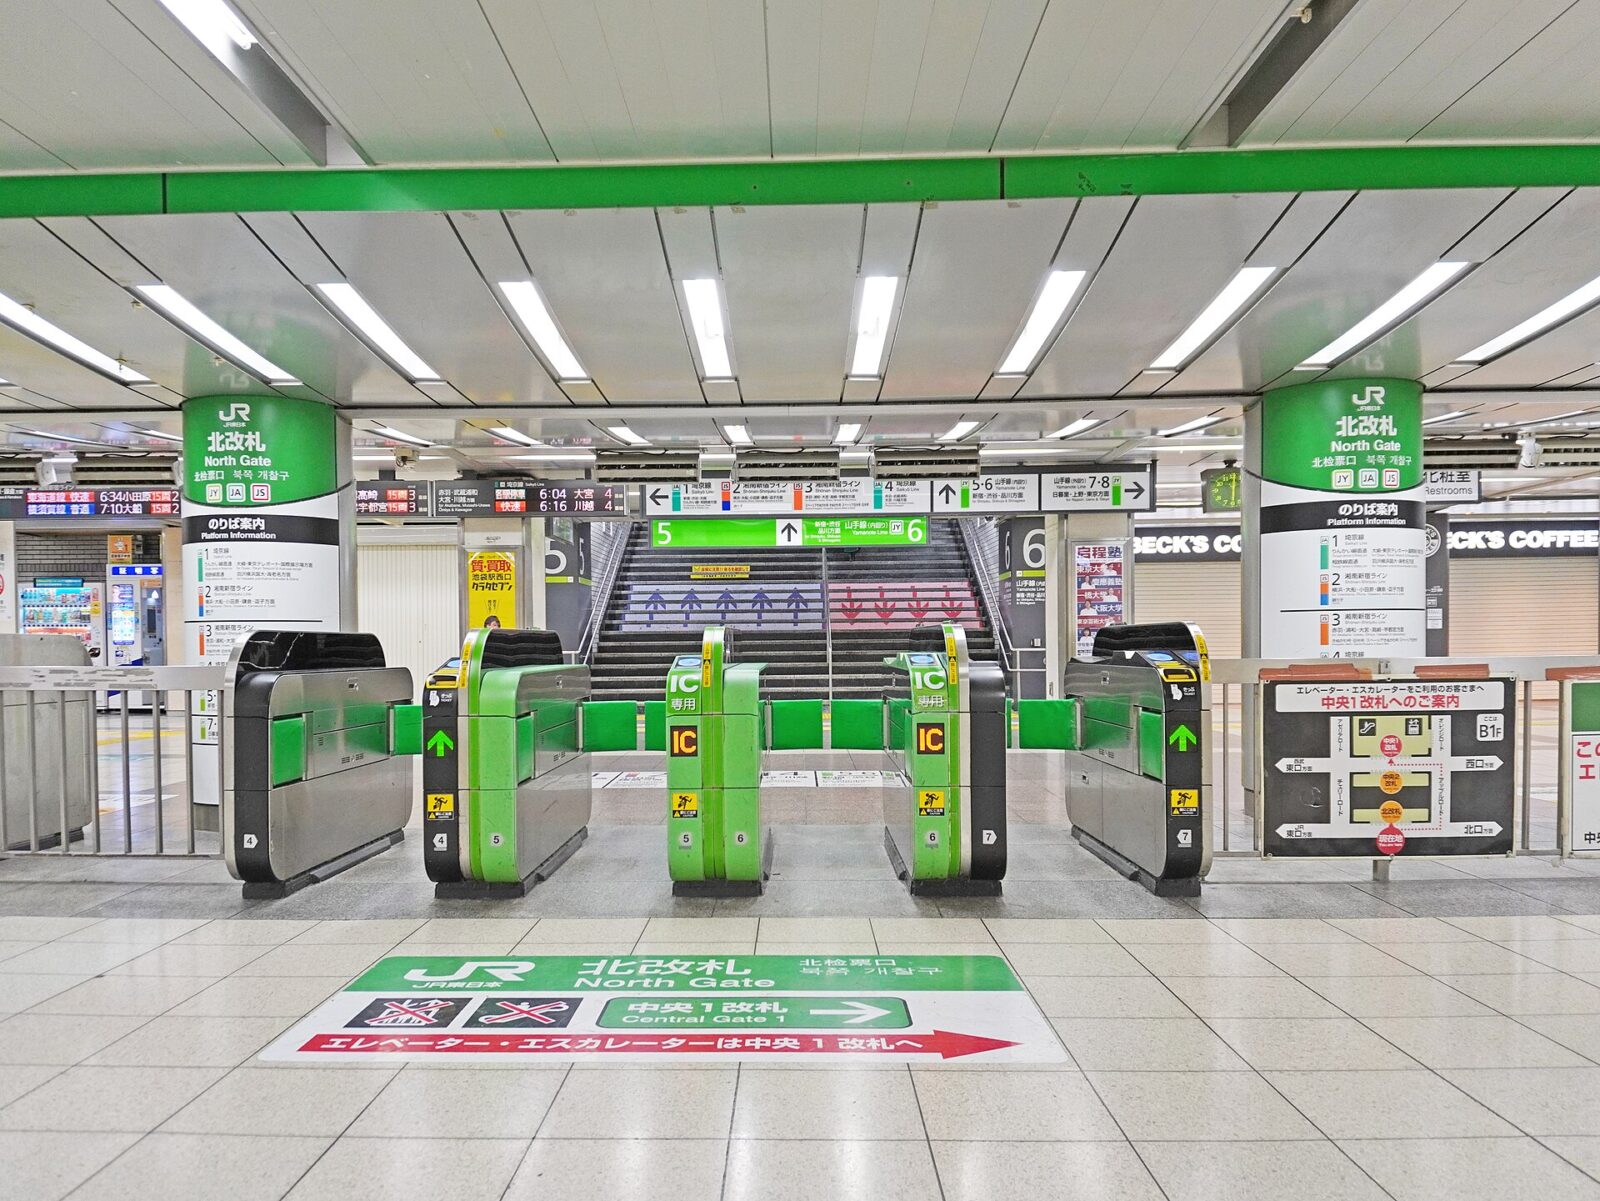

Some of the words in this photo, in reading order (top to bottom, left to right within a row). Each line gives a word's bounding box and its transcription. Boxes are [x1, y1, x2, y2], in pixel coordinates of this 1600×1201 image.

[1352, 386, 1386, 404] JR
[218, 403, 250, 420] JR
[1336, 415, 1397, 436] 北改札
[208, 432, 266, 452] 北改札
[1331, 440, 1370, 452] North
[1374, 440, 1400, 451] Gate
[204, 456, 236, 466] North
[240, 455, 272, 466] Gate
[1366, 456, 1386, 464] 북쪽
[232, 470, 252, 480] 북쪽
[258, 470, 289, 480] 개찰구
[806, 483, 812, 492] 3
[885, 481, 893, 491] 4
[70, 492, 90, 502] 快速
[100, 492, 122, 502] 6:34
[122, 492, 151, 502] 小田原
[172, 492, 179, 502] 2
[409, 490, 416, 500] 3
[540, 489, 567, 499] 6:04
[574, 489, 594, 499] 大宮
[604, 489, 612, 498] 4
[100, 504, 123, 514] 7:10
[123, 504, 142, 514] 大船
[172, 504, 179, 514] 2
[409, 502, 416, 512] 3
[501, 502, 522, 512] 快速
[540, 501, 567, 512] 6:16
[574, 502, 594, 512] 川越
[604, 501, 612, 511] 4
[1338, 503, 1398, 516] のりば案内
[208, 518, 266, 530] のりば案内
[658, 522, 672, 544] 5
[908, 519, 922, 542] 6
[1133, 535, 1209, 554] BECK'S
[1332, 535, 1338, 547] 1
[1508, 530, 1599, 549] COFFEE
[1004, 531, 1010, 570] 6
[1023, 528, 1045, 568] 6
[204, 548, 208, 560] 1
[472, 560, 512, 573] 質・買取
[1332, 572, 1340, 586] 2
[206, 586, 211, 597] 2
[472, 582, 512, 591] クラタセブン
[1332, 614, 1340, 626] 3
[206, 624, 212, 637] 3
[670, 674, 699, 692] IC
[914, 672, 945, 690] IC
[1297, 685, 1484, 694] エレベーター・エスカレーターをご利用のお客さまへ
[671, 698, 696, 711] 専用
[918, 695, 945, 708] 専用
[1322, 694, 1460, 710] 中央1改札へのご案内
[1480, 724, 1502, 738] B1F
[674, 731, 697, 754] IC
[920, 728, 943, 751] IC
[1286, 764, 1312, 772] 東口方面
[1466, 758, 1494, 768] 西口方面
[1286, 830, 1312, 838] 東口方面
[1464, 825, 1494, 834] 北口方面
[247, 837, 253, 845] 4
[494, 836, 500, 844] 5
[684, 834, 689, 843] 5
[738, 834, 744, 842] 6
[930, 833, 936, 841] 6
[986, 833, 992, 841] 7
[1182, 832, 1188, 840] 7
[1378, 834, 1404, 843] 現在地
[404, 962, 536, 982] JR
[577, 960, 752, 976] 北改札
[864, 968, 944, 976] 개찰구
[574, 978, 675, 988] North
[689, 978, 776, 988] Gate
[628, 1002, 788, 1013] 中央1改札
[622, 1016, 704, 1024] Central
[712, 1016, 767, 1024] Gate
[320, 1038, 924, 1050] エレベーター・エスカレーターは中央1改札へ
